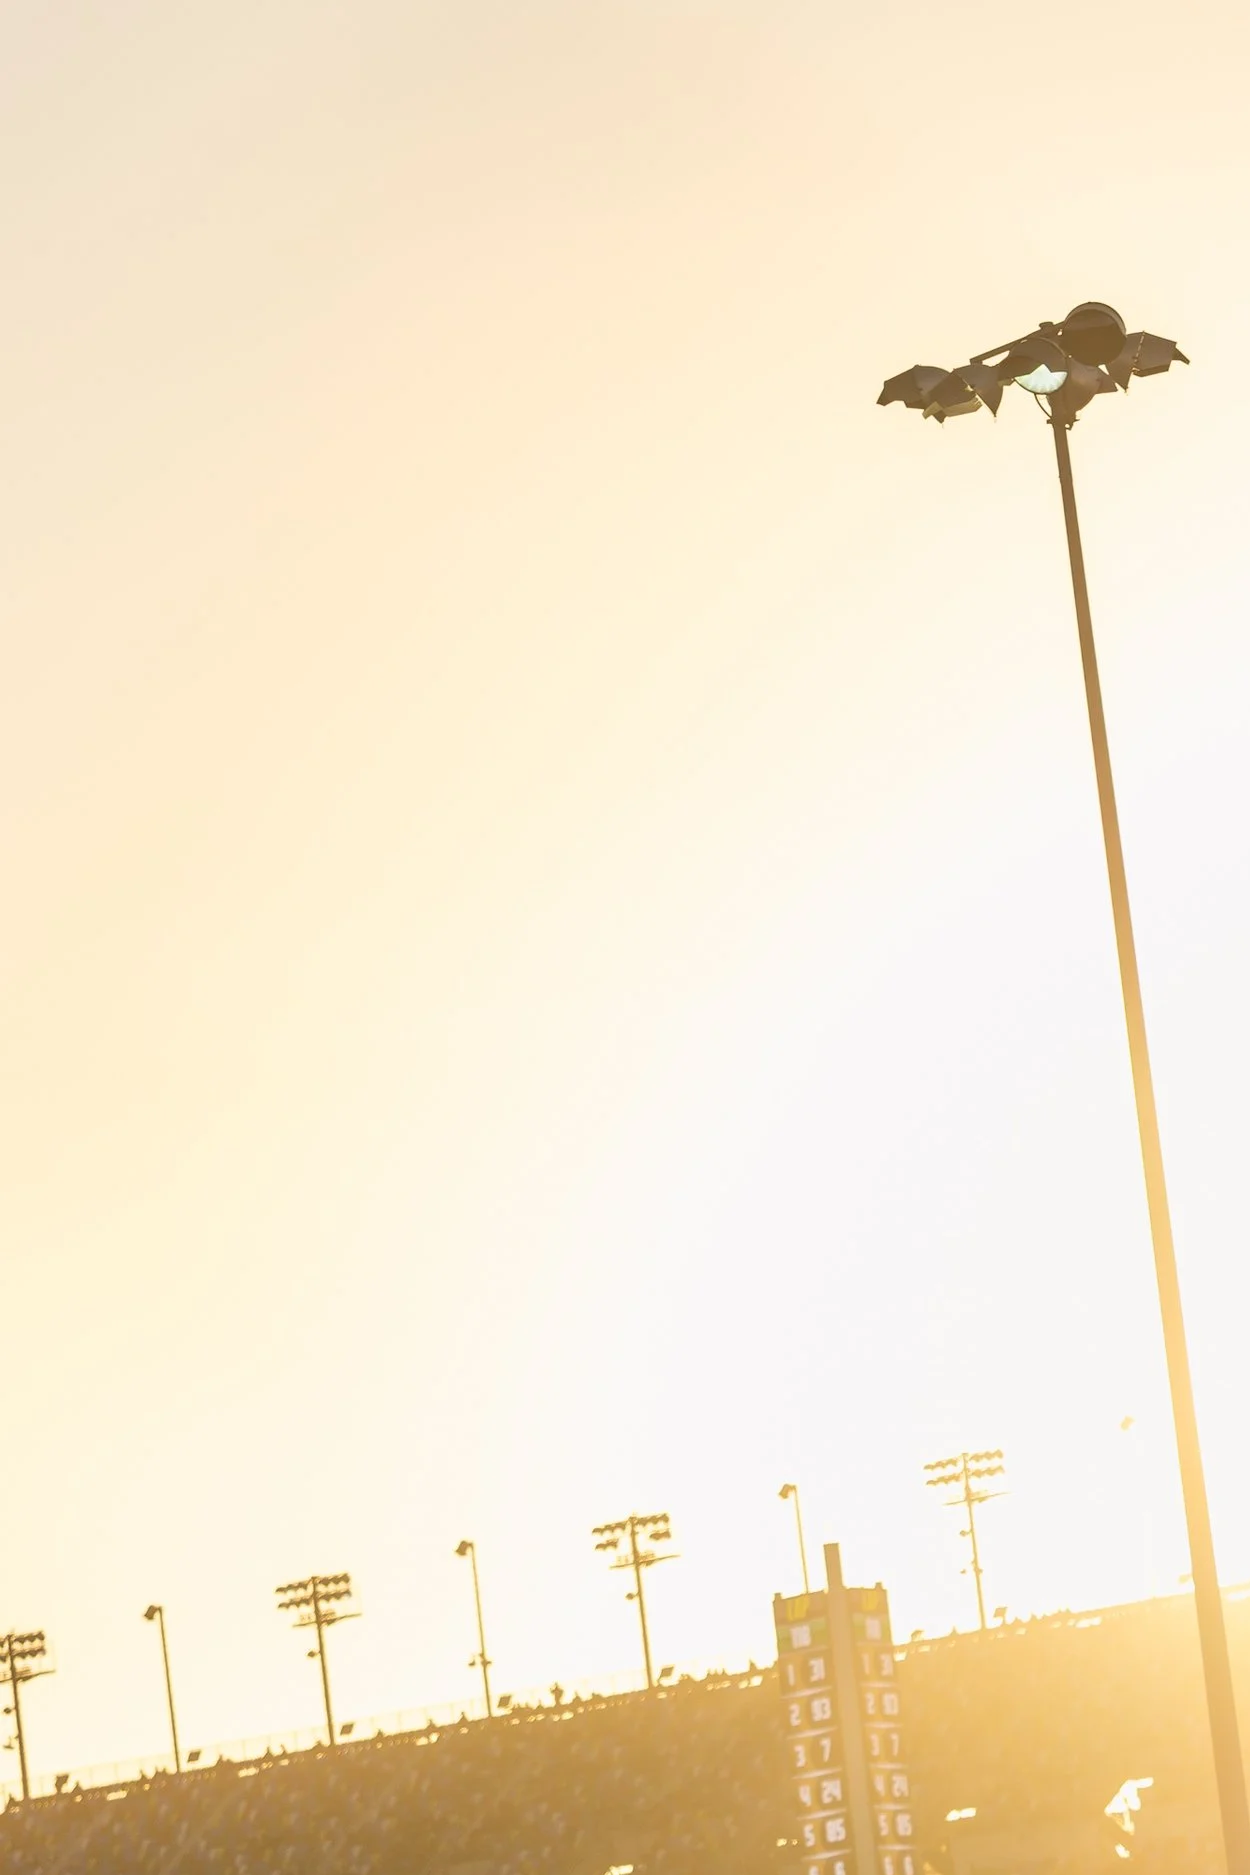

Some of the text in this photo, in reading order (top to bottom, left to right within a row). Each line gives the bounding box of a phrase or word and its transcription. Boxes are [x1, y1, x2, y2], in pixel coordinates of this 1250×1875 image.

[787, 1664, 795, 1686] 1
[862, 1653, 870, 1675] 1
[789, 1703, 801, 1726] 2
[865, 1692, 875, 1715] 2
[794, 1737, 831, 1768] 3 7
[870, 1733, 899, 1756] 3 7
[799, 1778, 842, 1807] 4 24
[874, 1774, 909, 1798] 4 24
[804, 1823, 816, 1847] 5
[878, 1813, 889, 1836] 5
